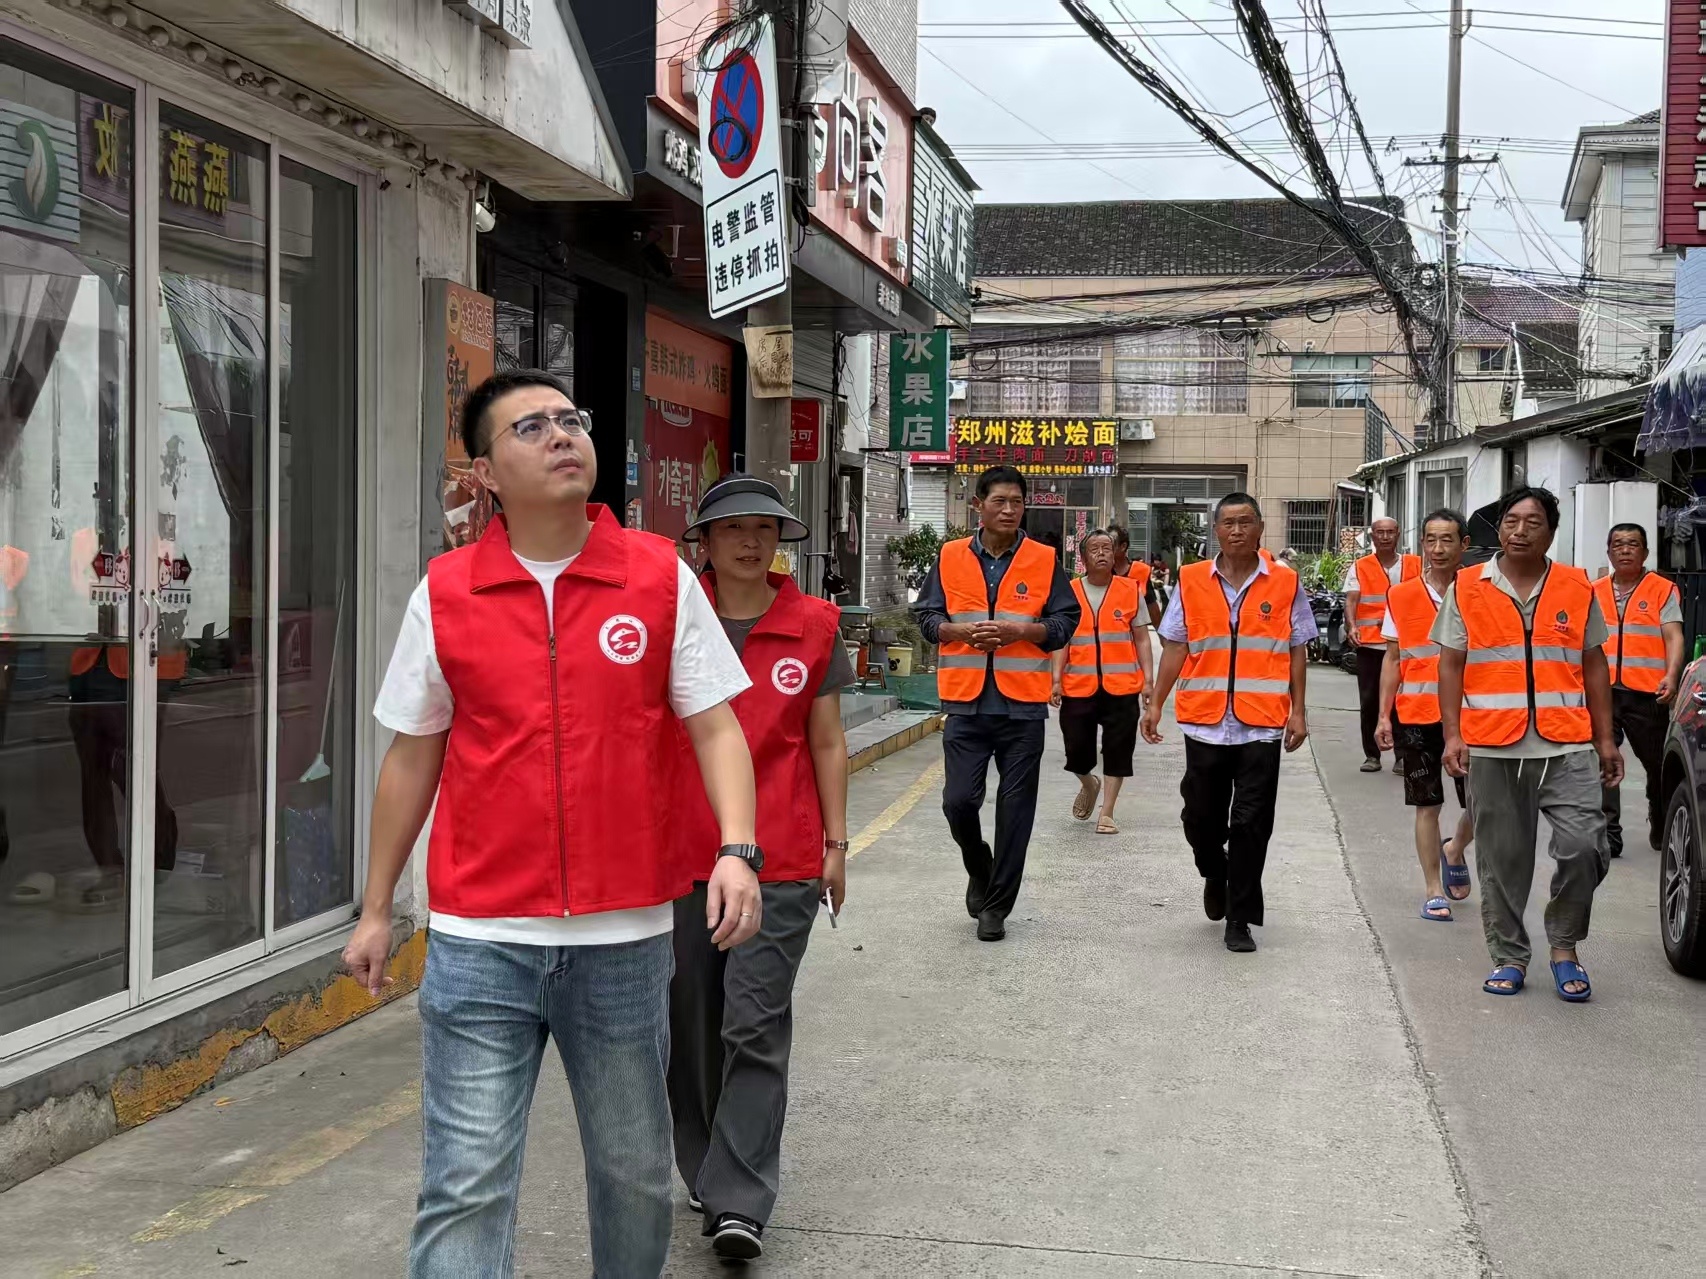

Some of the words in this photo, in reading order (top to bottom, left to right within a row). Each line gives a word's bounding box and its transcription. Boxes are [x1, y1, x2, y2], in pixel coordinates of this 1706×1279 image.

[711, 190, 775, 249] 电警监管
[714, 238, 780, 295] 违停抓拍
[901, 332, 934, 447] 水果店
[957, 419, 1117, 447] 郑州滋补烩面
[1064, 449, 1115, 463] 刀削面
